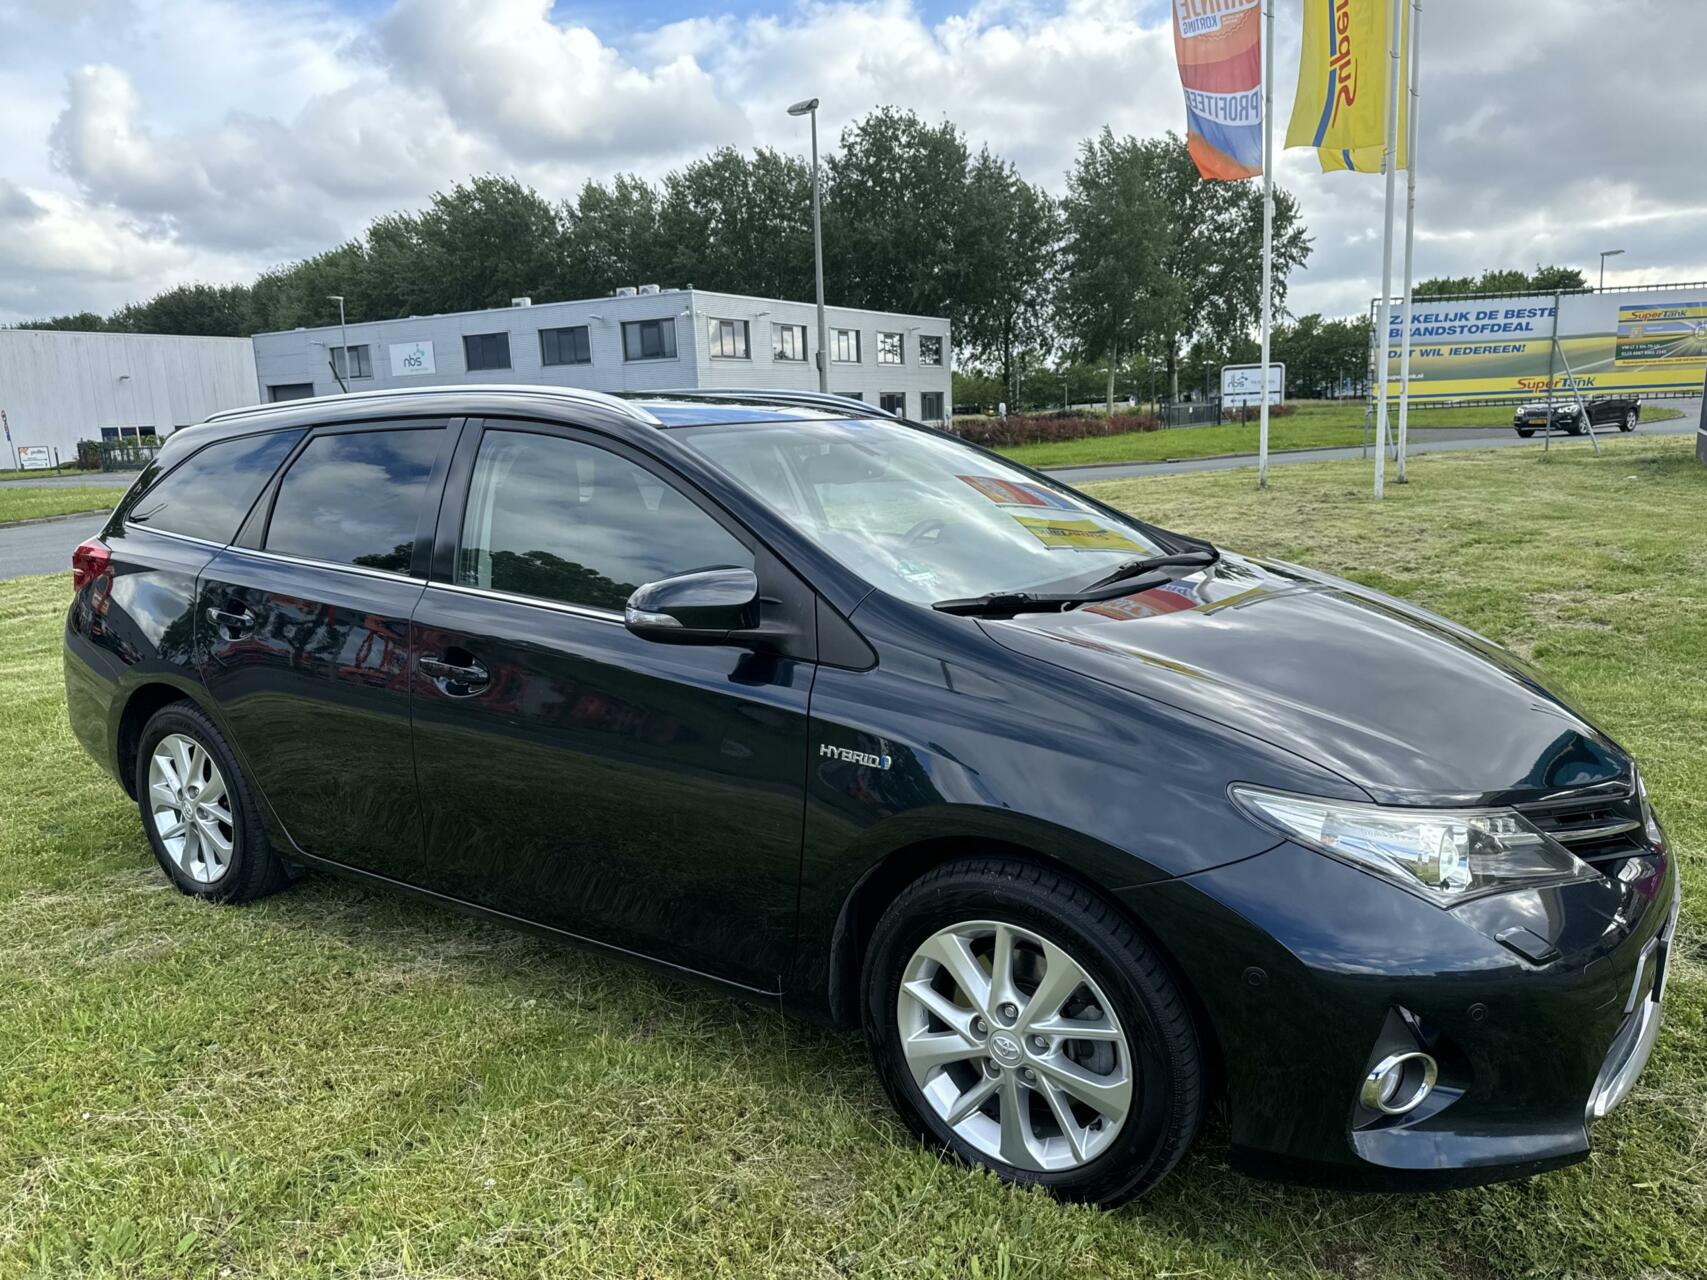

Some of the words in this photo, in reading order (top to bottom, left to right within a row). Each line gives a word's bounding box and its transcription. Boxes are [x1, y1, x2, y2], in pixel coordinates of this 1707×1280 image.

[1389, 311, 1471, 325] ZKELIJK
[1475, 310, 1499, 321] DE
[1503, 307, 1559, 320] BESTE
[1420, 348, 1444, 358] WIL
[1449, 344, 1527, 356] IEDEREEN!
[819, 743, 881, 768] HYBRID
